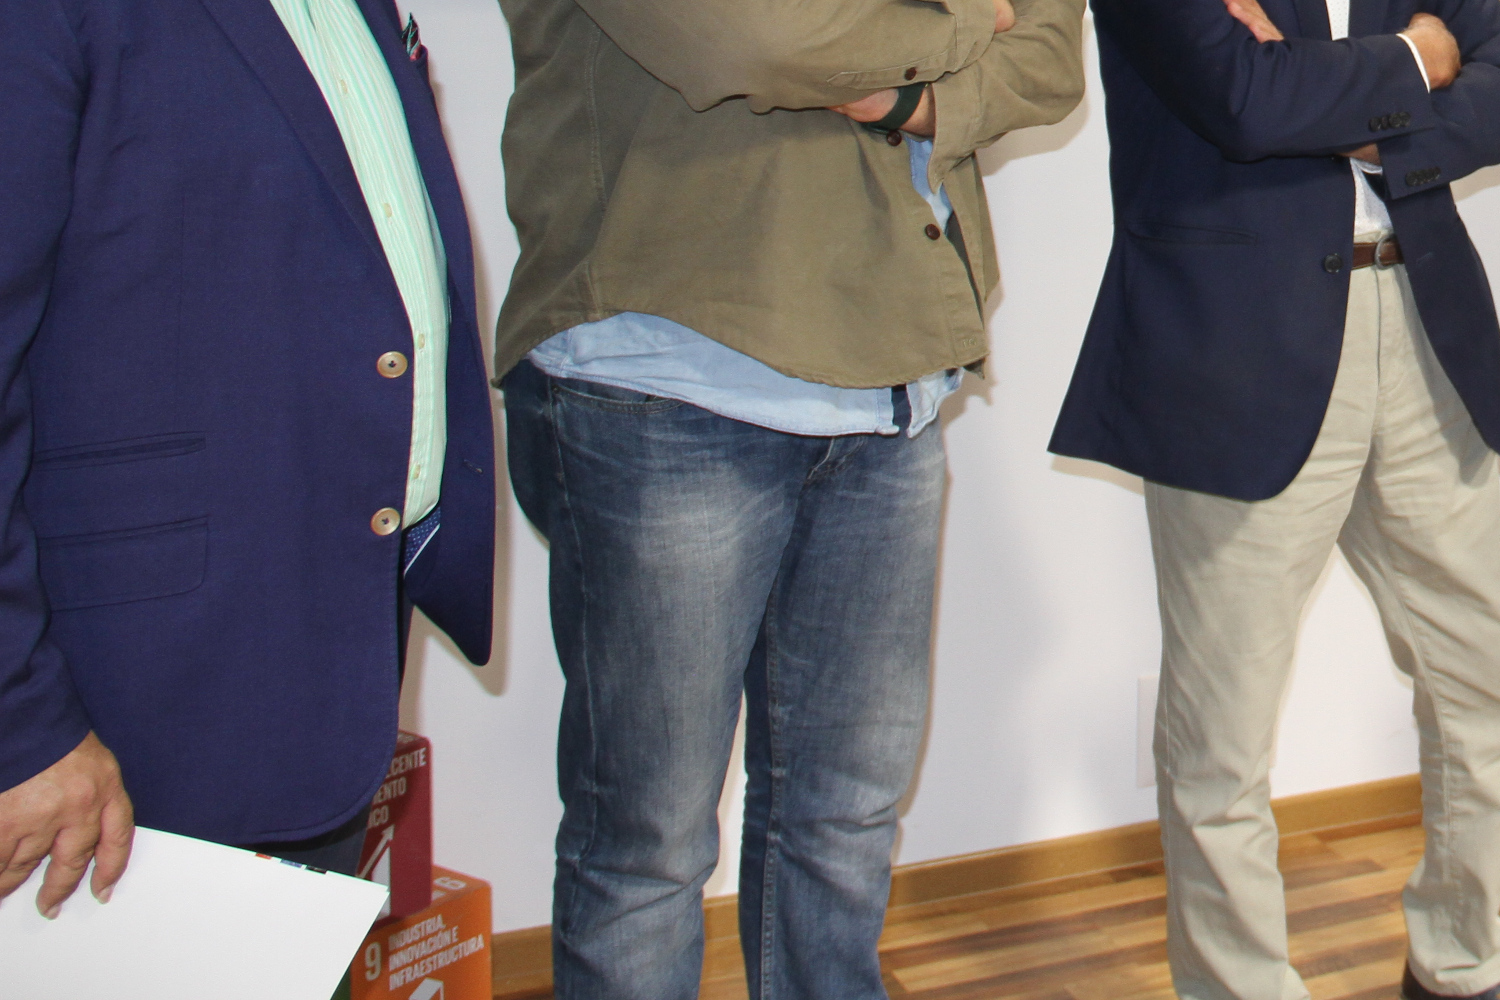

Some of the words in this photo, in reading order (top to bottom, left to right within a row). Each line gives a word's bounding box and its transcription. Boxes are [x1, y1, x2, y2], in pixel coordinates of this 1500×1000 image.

[365, 942, 381, 981] 9
[389, 929, 451, 972] INNOVACIÓN
[452, 925, 458, 944] E
[389, 933, 485, 991] INFRAESTRUCTURA
